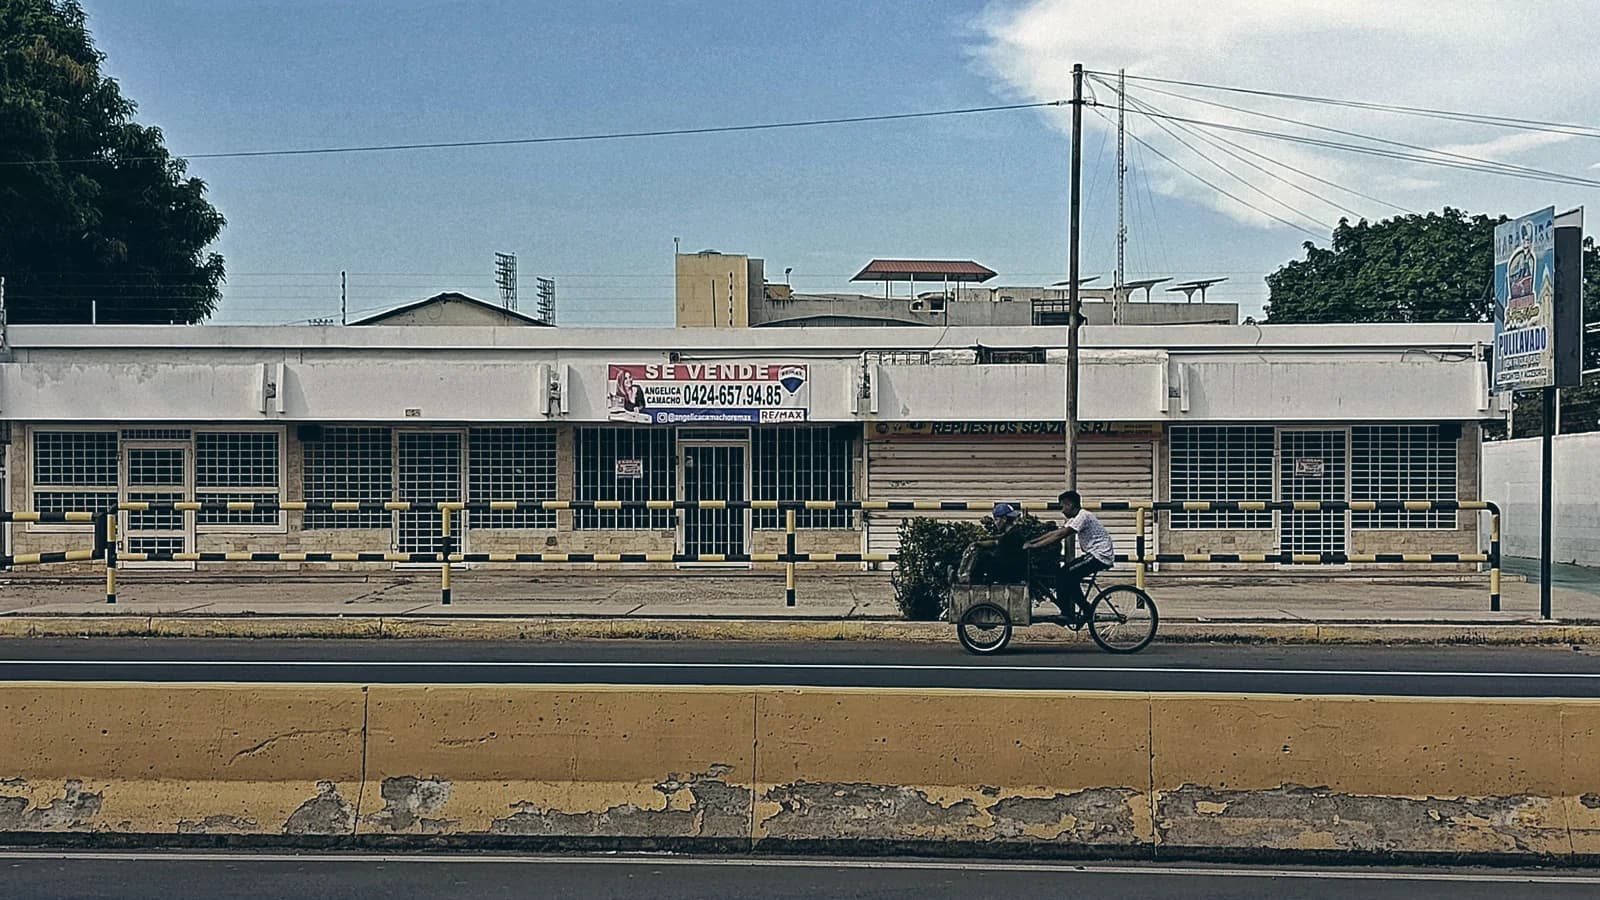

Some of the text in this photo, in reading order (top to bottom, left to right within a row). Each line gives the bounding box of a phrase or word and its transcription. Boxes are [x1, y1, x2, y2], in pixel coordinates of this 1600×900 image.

[1498, 327, 1547, 357] PULILAVADO
[645, 364, 769, 380] SE VENDE
[644, 387, 681, 395] ANGELICA
[683, 384, 782, 406] 0424-657.94.85
[647, 396, 681, 404] CAMACHO
[761, 411, 802, 420] RE/MAX
[931, 421, 1018, 435] REPUESTOS
